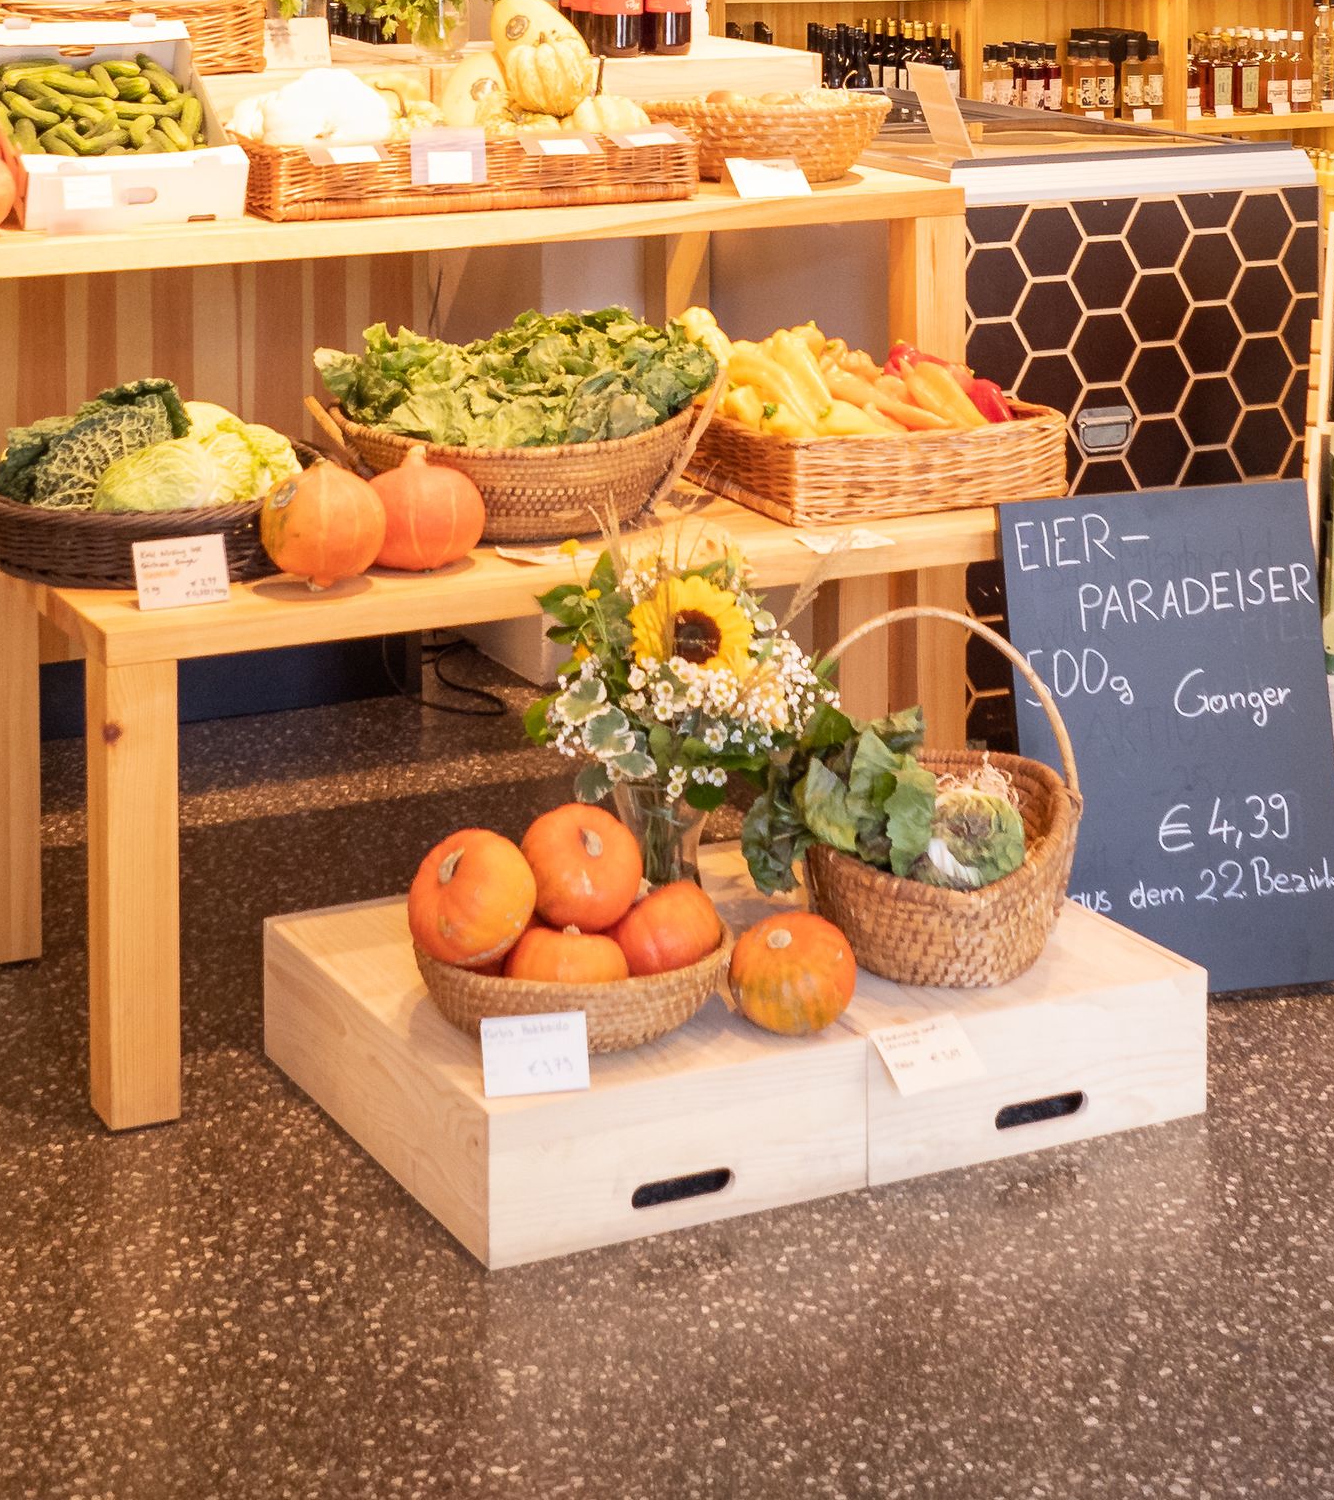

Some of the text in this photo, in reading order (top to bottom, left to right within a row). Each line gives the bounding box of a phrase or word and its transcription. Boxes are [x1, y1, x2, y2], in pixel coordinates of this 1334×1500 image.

[1079, 563, 1315, 631] PARADEISER
[1174, 668, 1291, 727] Ganger
[1159, 793, 1290, 851] € 4,39
[1129, 881, 1185, 909] dem
